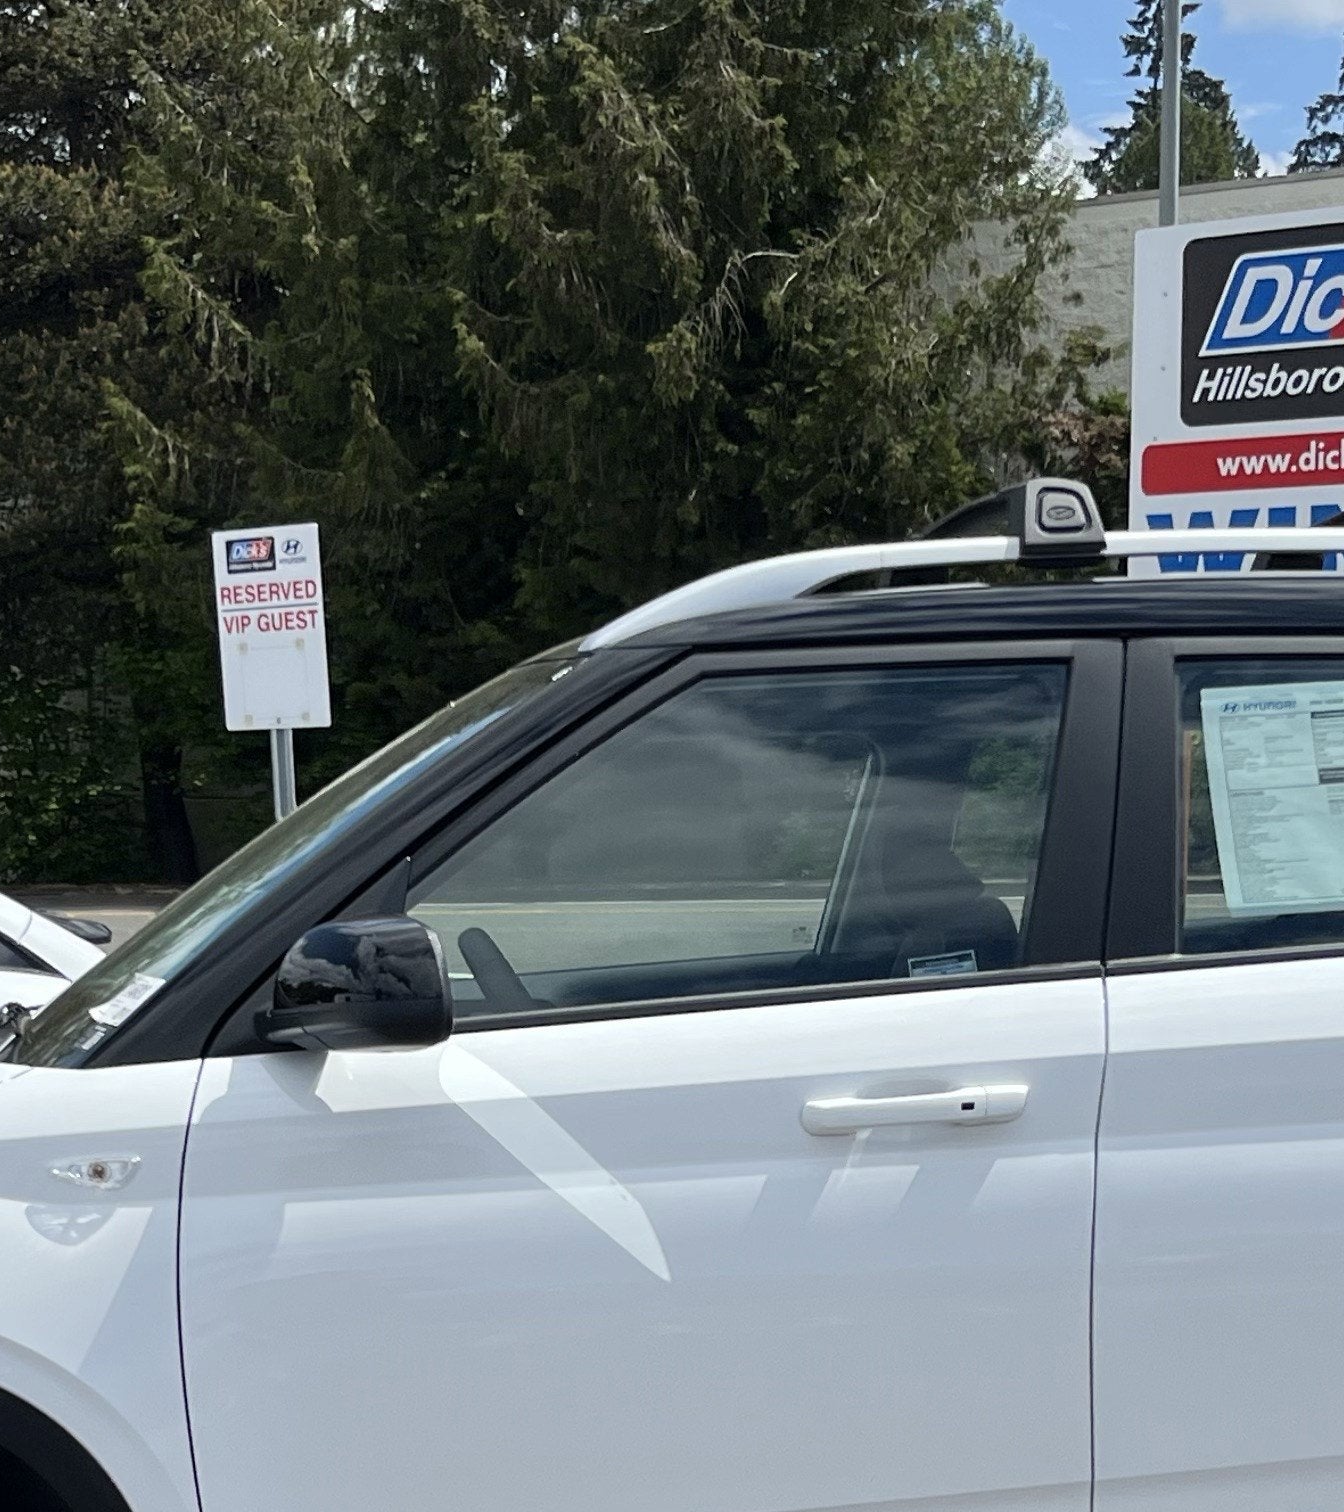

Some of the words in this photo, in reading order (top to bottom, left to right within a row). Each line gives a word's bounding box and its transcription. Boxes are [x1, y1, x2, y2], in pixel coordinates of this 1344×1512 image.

[220, 579, 318, 606] RESERVED
[222, 615, 252, 634] VIP
[257, 609, 318, 632] GUEST
